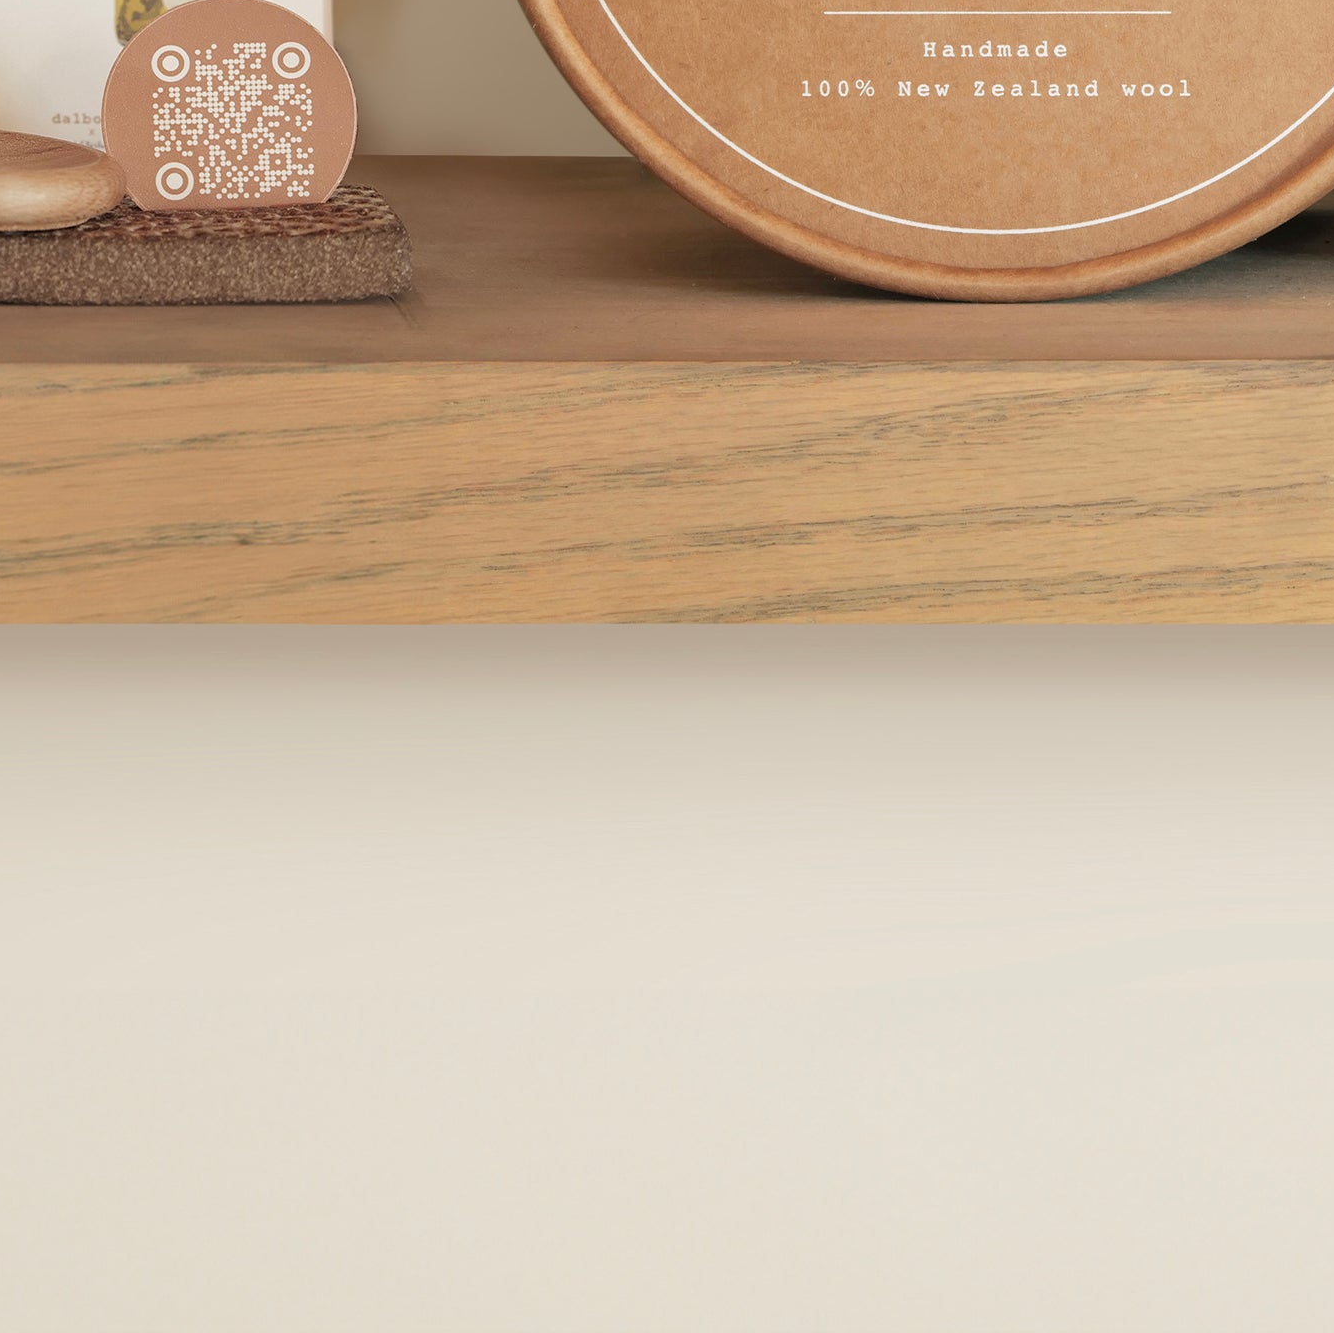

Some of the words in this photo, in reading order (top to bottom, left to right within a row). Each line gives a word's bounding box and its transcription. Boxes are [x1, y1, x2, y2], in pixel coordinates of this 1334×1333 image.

[922, 40, 1069, 58] Handmade
[801, 79, 876, 98] 100%
[898, 79, 951, 97] New
[973, 79, 1099, 97] Zealand
[1121, 79, 1192, 97] wool
[51, 112, 101, 124] dalbo
